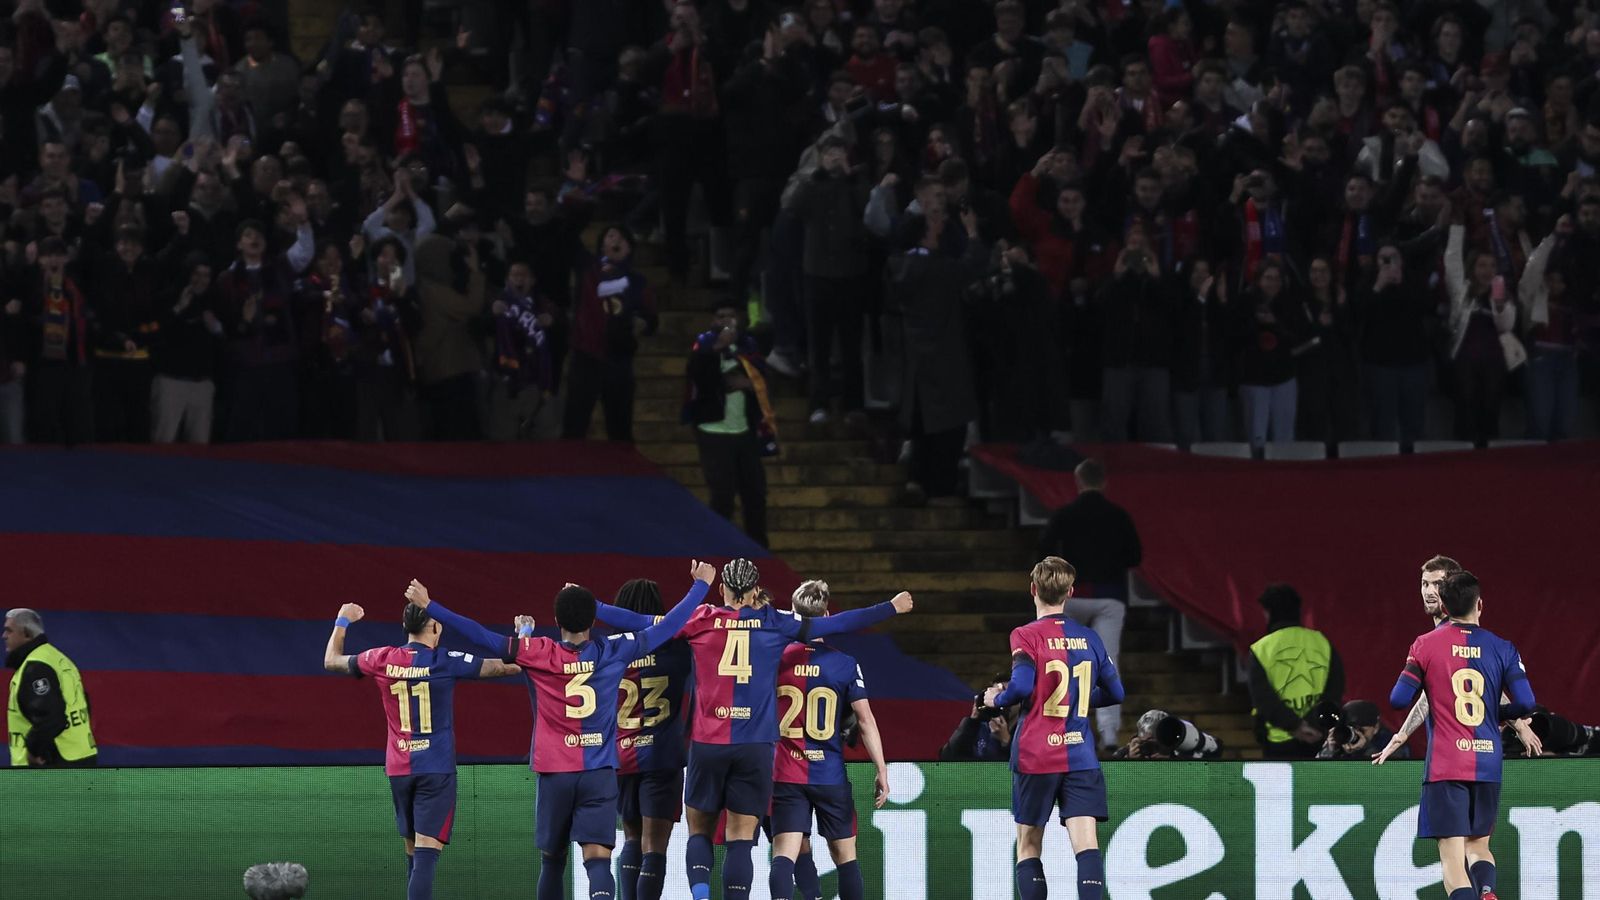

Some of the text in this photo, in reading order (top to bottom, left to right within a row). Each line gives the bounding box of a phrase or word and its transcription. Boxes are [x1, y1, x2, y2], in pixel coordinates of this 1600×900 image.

[563, 661, 595, 674] BALDE
[718, 630, 752, 684] 4
[794, 665, 820, 677] OLMO
[1452, 645, 1481, 659] PEDRI
[389, 680, 433, 734] 11
[565, 672, 597, 719] 3
[617, 675, 671, 730] 23
[777, 685, 838, 741] 20
[1043, 660, 1092, 718] 21
[1451, 668, 1485, 727] 8
